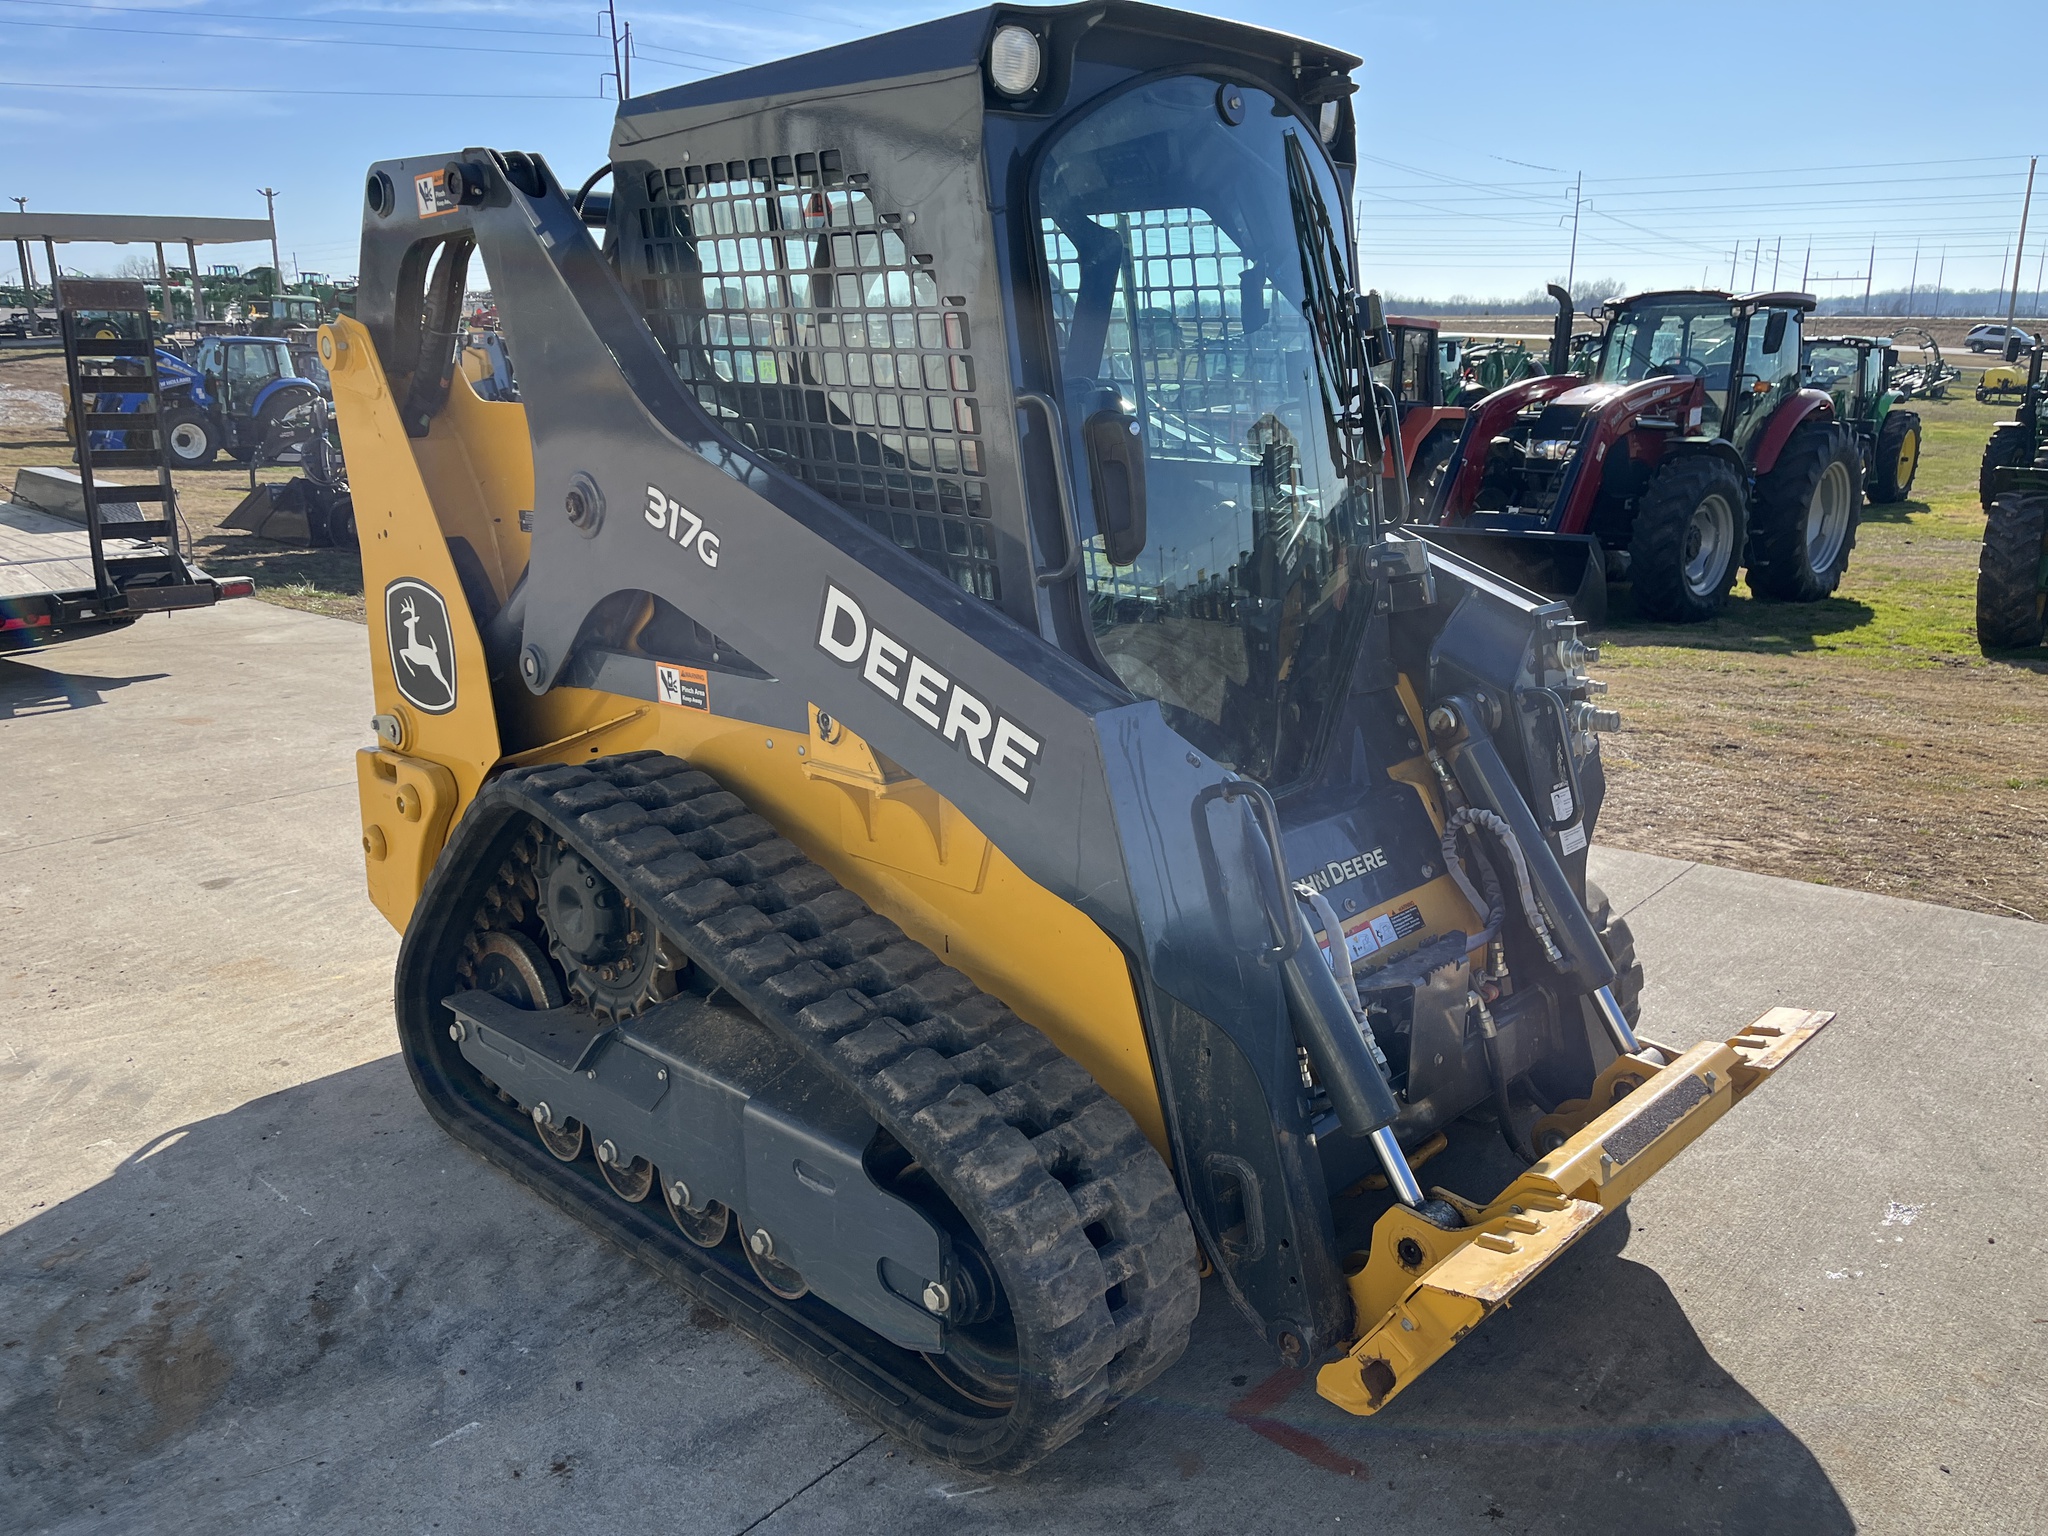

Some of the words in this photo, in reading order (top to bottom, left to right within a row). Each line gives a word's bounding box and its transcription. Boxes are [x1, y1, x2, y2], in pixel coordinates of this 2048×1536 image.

[644, 486, 720, 568] 317G
[681, 685, 694, 695] Pinch
[694, 688, 706, 697] Area
[682, 694, 692, 703] Keep
[692, 696, 703, 706] Away
[818, 584, 1040, 794] DEERE
[1300, 870, 1331, 893] HN
[1326, 848, 1388, 885] DEERE
